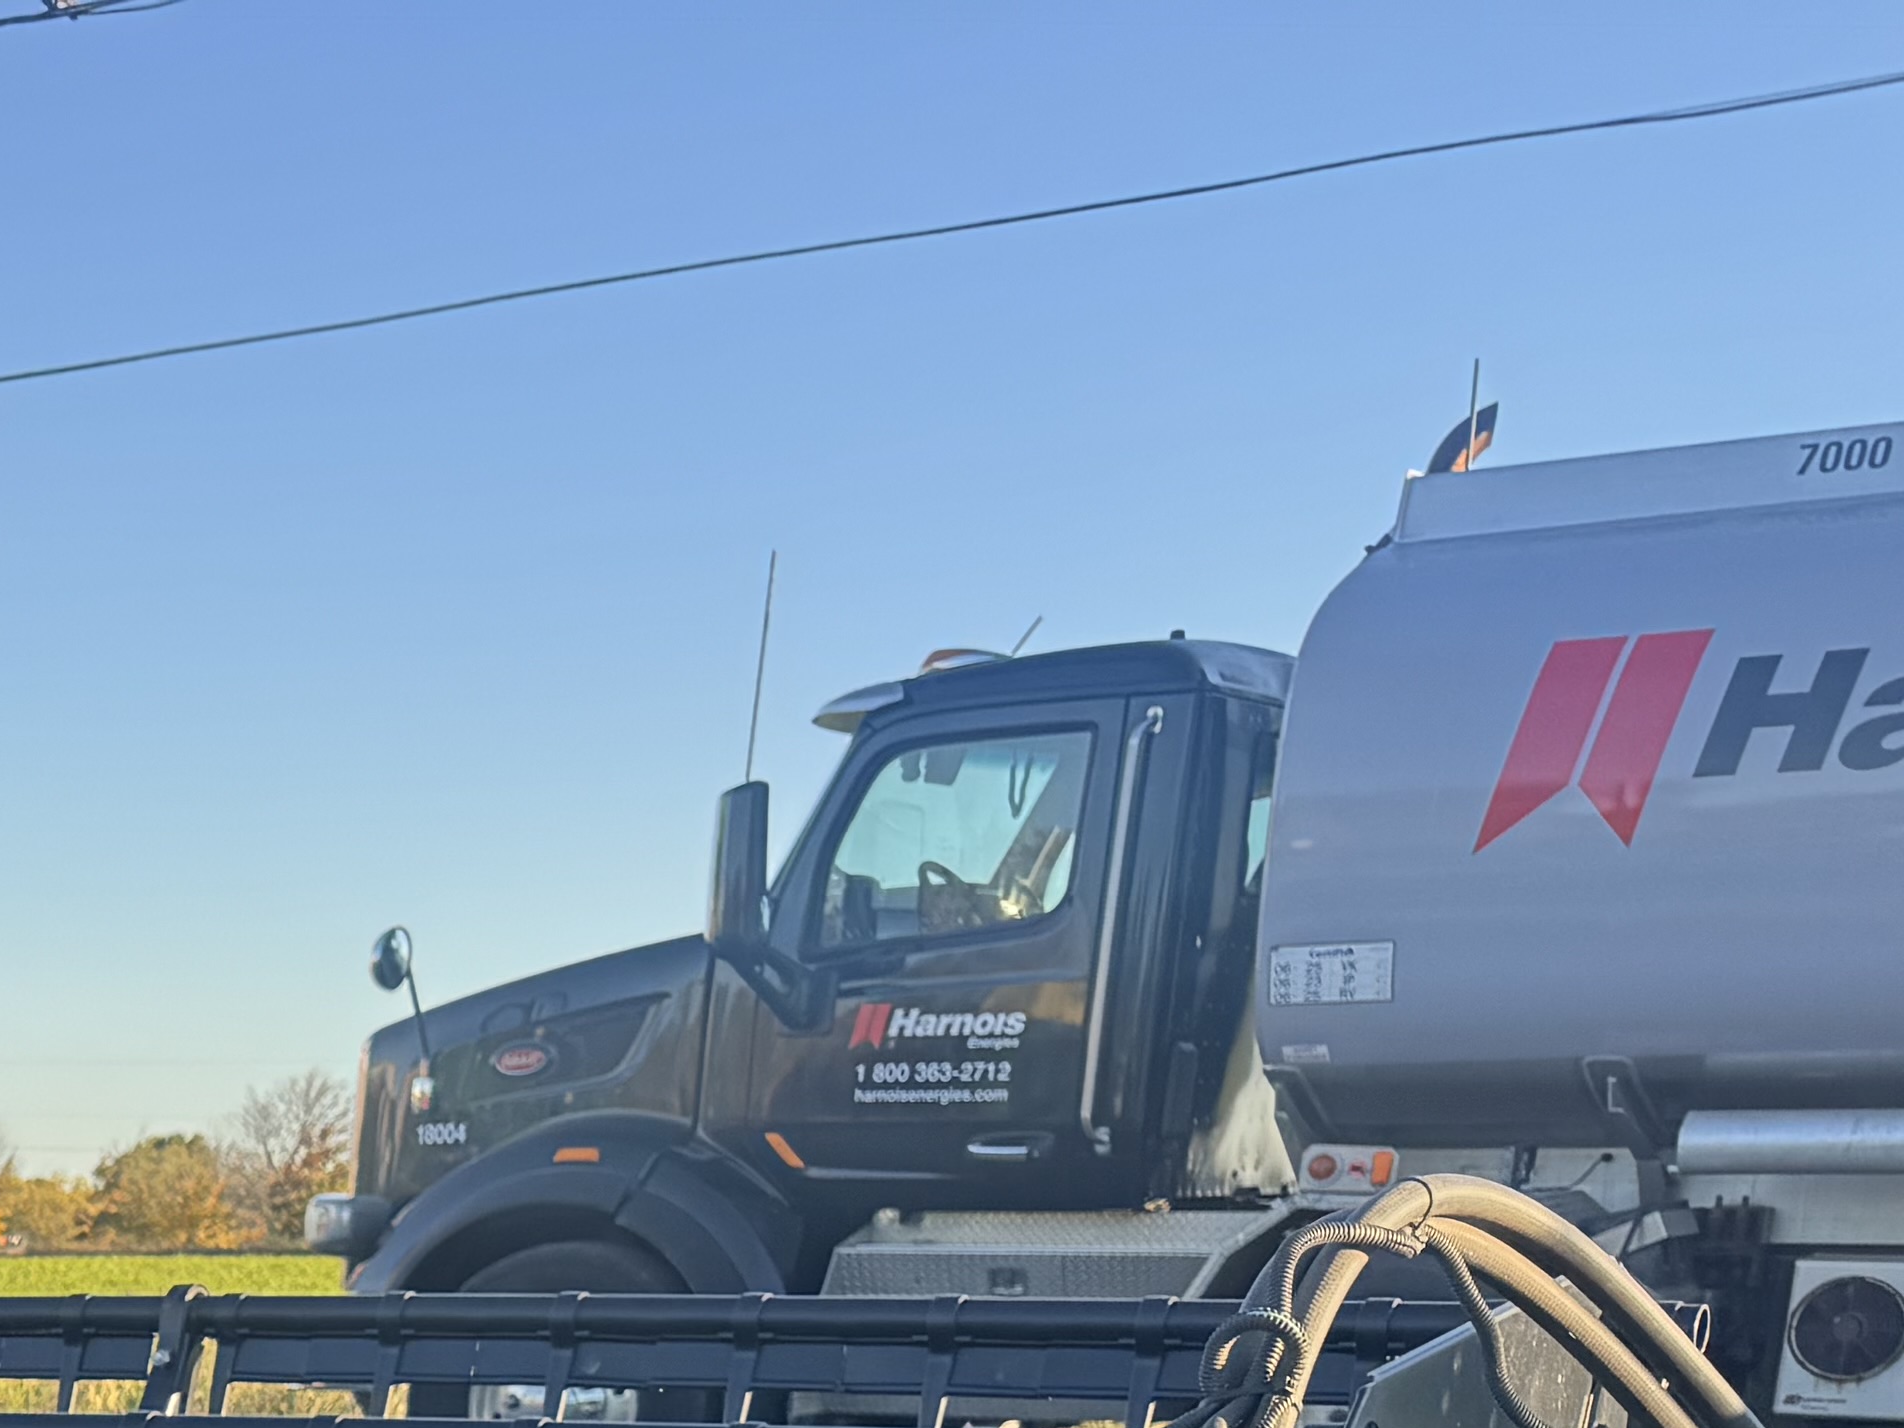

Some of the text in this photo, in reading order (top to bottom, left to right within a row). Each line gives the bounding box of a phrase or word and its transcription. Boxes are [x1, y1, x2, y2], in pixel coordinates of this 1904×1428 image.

[1796, 436, 1893, 476] 7000
[888, 1007, 1027, 1038] Harnois
[855, 1061, 1012, 1083] 1 800 363-2712
